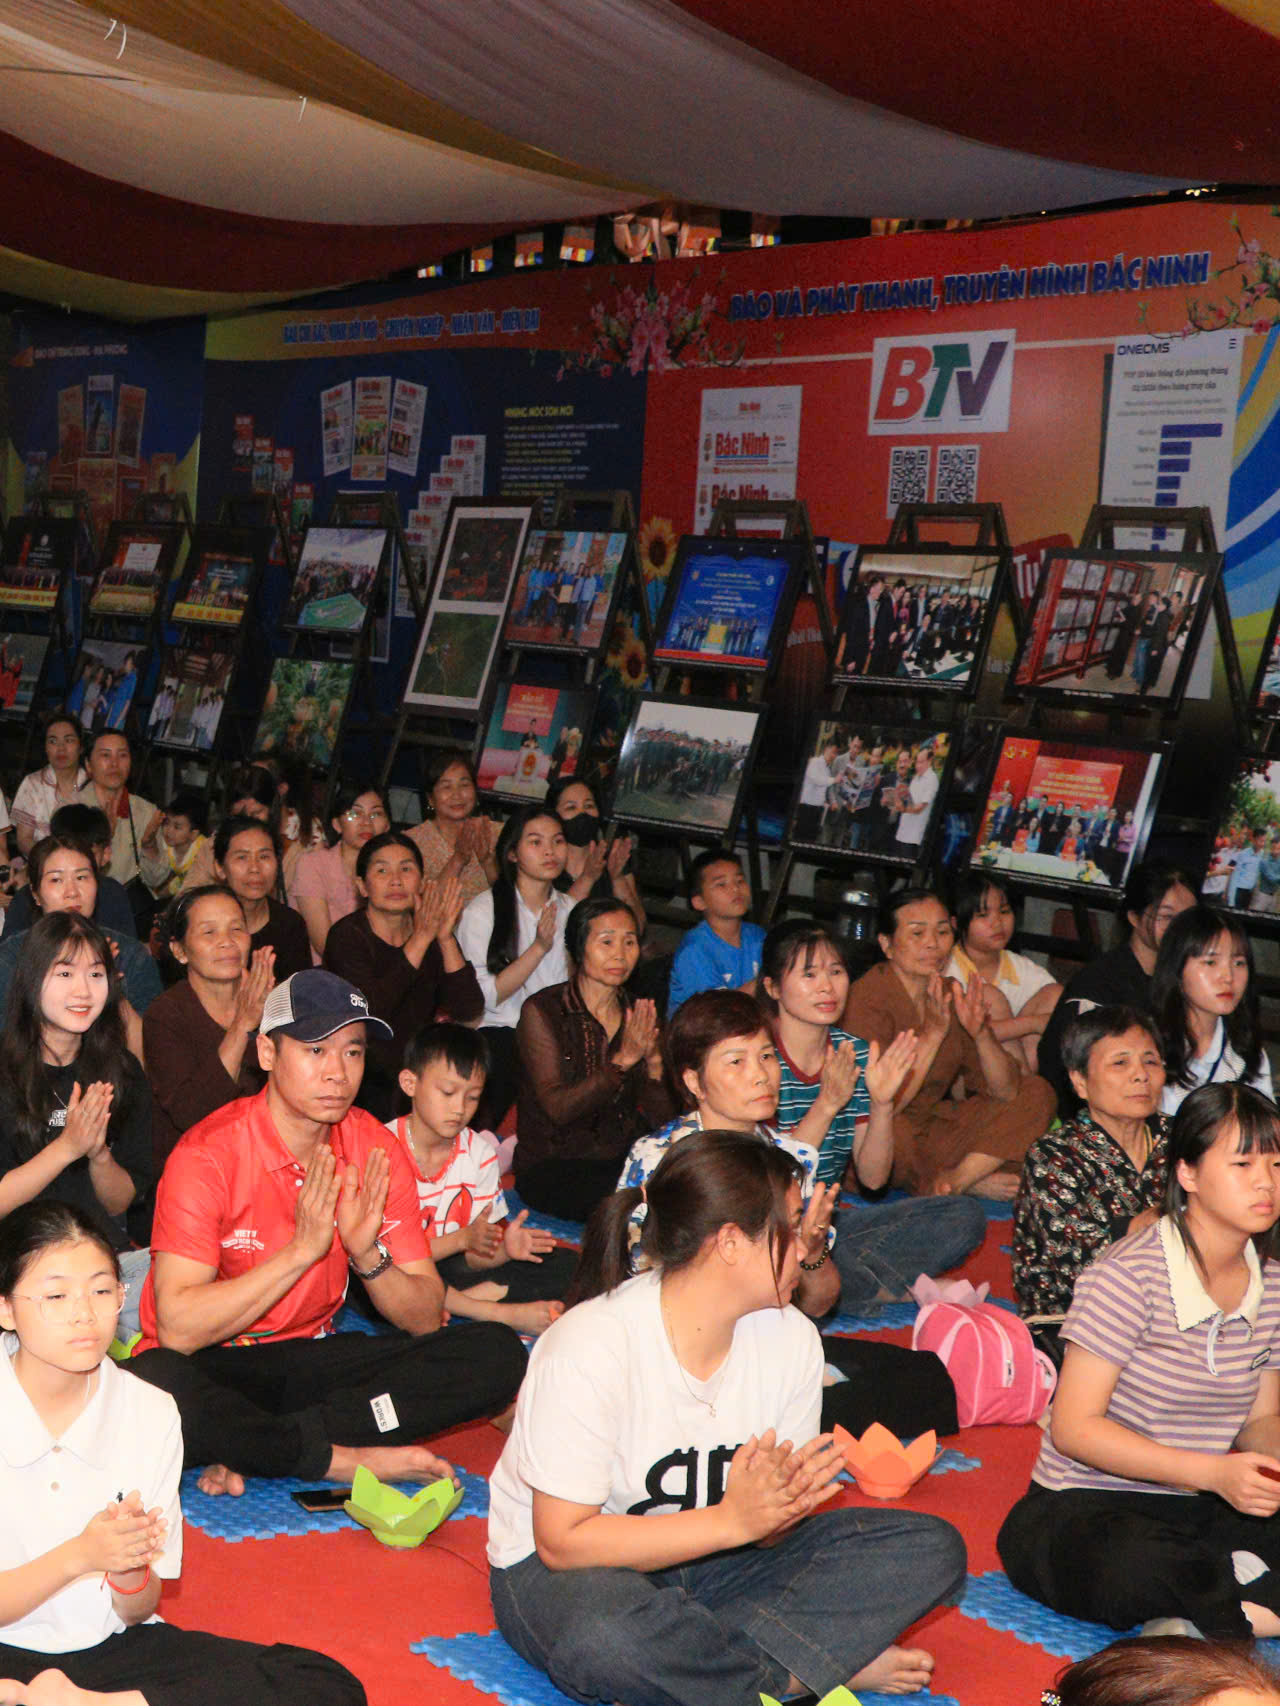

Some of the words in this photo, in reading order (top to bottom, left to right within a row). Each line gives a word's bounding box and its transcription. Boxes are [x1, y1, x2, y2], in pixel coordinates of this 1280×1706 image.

[729, 289, 773, 322] BÁO
[775, 285, 805, 319] VÀ
[806, 281, 861, 316] PHÁT
[861, 276, 939, 313] THANH,
[943, 263, 1028, 306] TRUYỀN
[1028, 261, 1090, 298] HÌNH
[1091, 252, 1144, 293] BẮC
[1145, 250, 1213, 290] NINH
[872, 340, 1010, 421] BTV
[741, 431, 770, 455] Ninh
